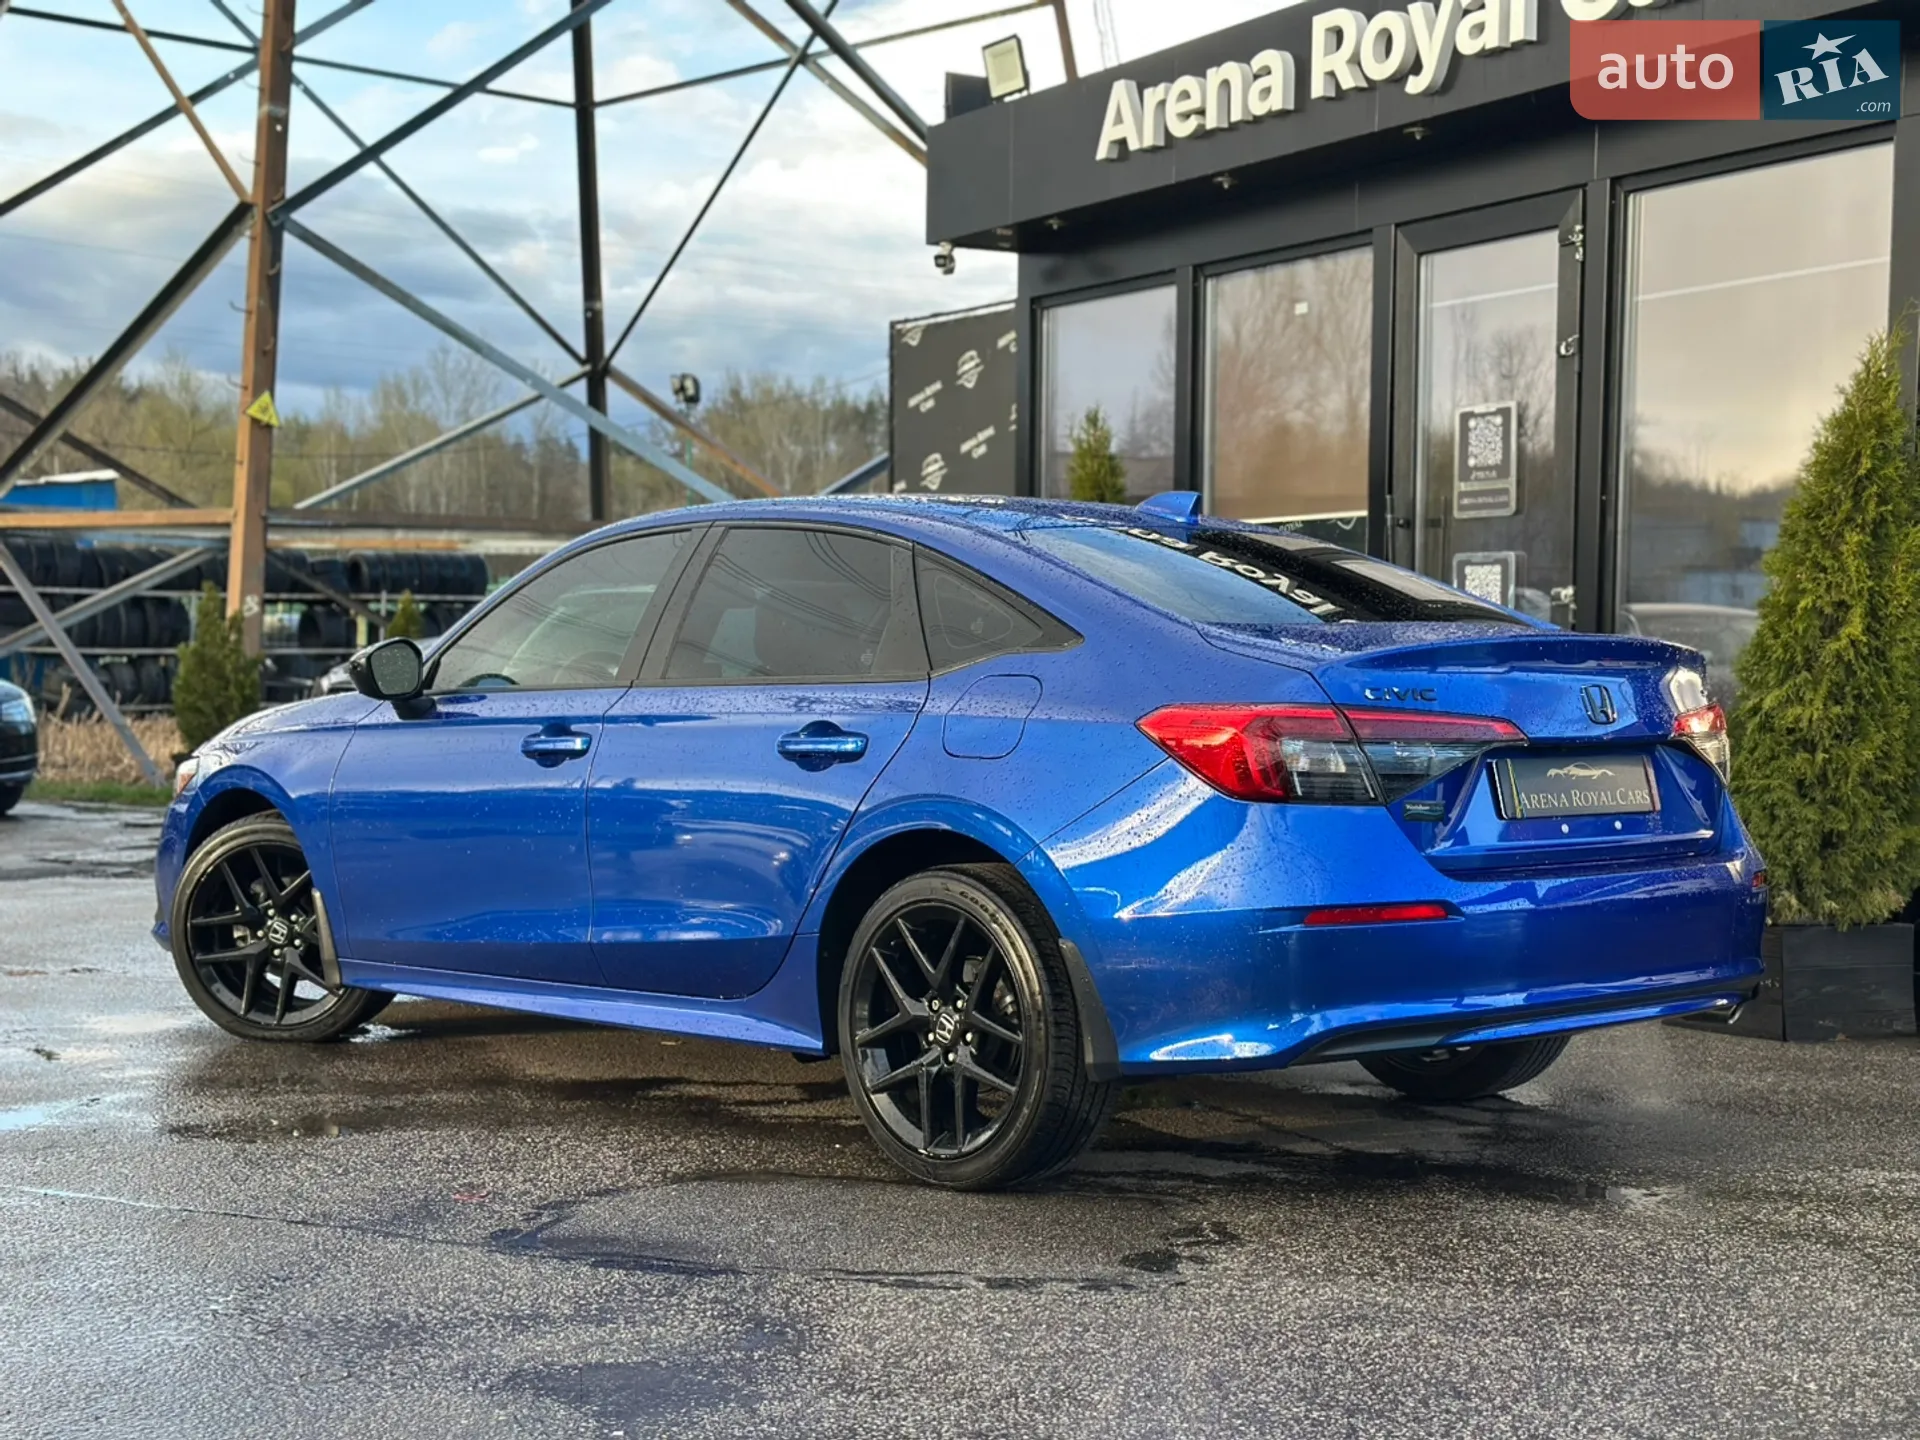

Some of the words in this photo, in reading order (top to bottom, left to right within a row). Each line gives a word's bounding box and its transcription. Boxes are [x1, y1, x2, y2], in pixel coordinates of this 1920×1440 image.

[1095, 49, 1295, 161] Arena
[1364, 687, 1438, 702] CIVIC
[1520, 792, 1569, 809] ARENA
[1571, 789, 1616, 807] ROYAL
[1617, 788, 1650, 804] CARS
